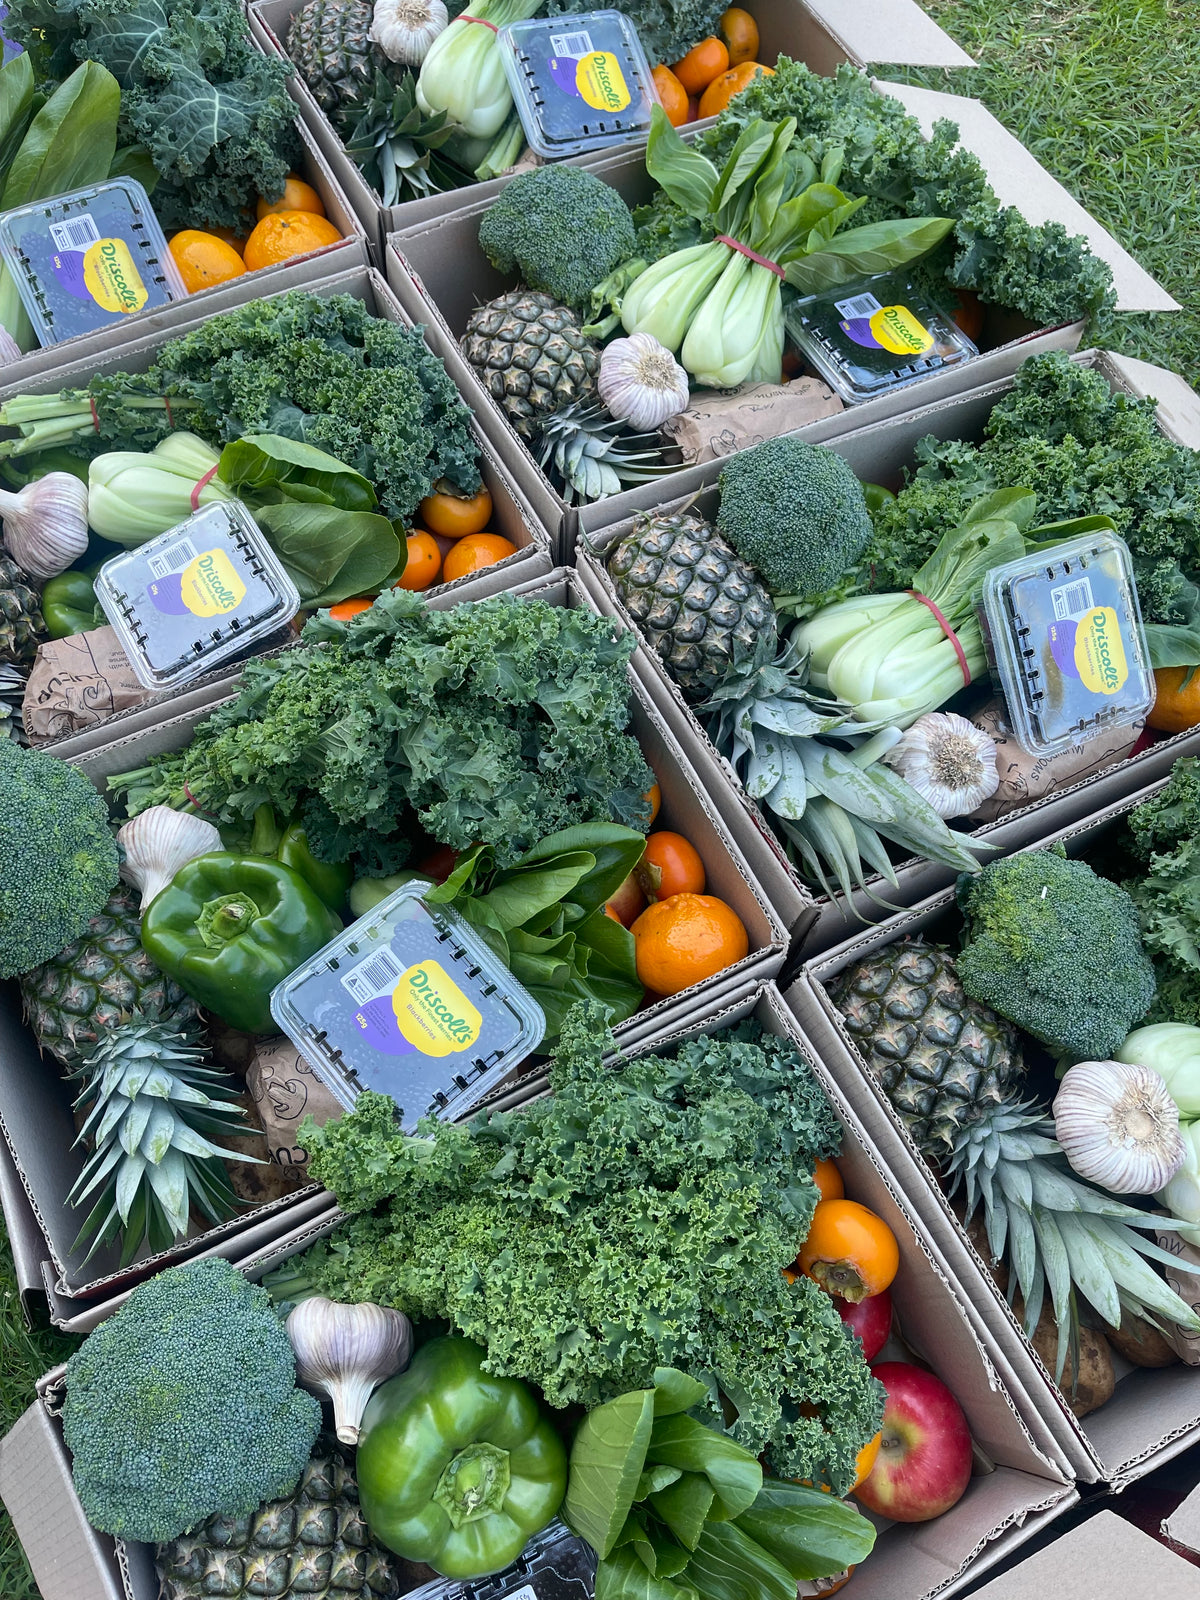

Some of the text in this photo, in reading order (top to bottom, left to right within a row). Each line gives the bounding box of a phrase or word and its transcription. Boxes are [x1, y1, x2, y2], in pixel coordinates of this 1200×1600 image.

[593, 55, 621, 108] Driscoll's
[101, 243, 138, 308] Driscoll's
[885, 308, 924, 352] Driscoll's
[199, 556, 236, 608] Driscoll's
[1093, 612, 1120, 688] Driscoll's
[355, 1012, 369, 1029] 125g
[406, 1004, 437, 1041] Blackberries
[409, 969, 473, 1043] Driscoll's
[409, 989, 453, 1041] Only the Finest Berries
